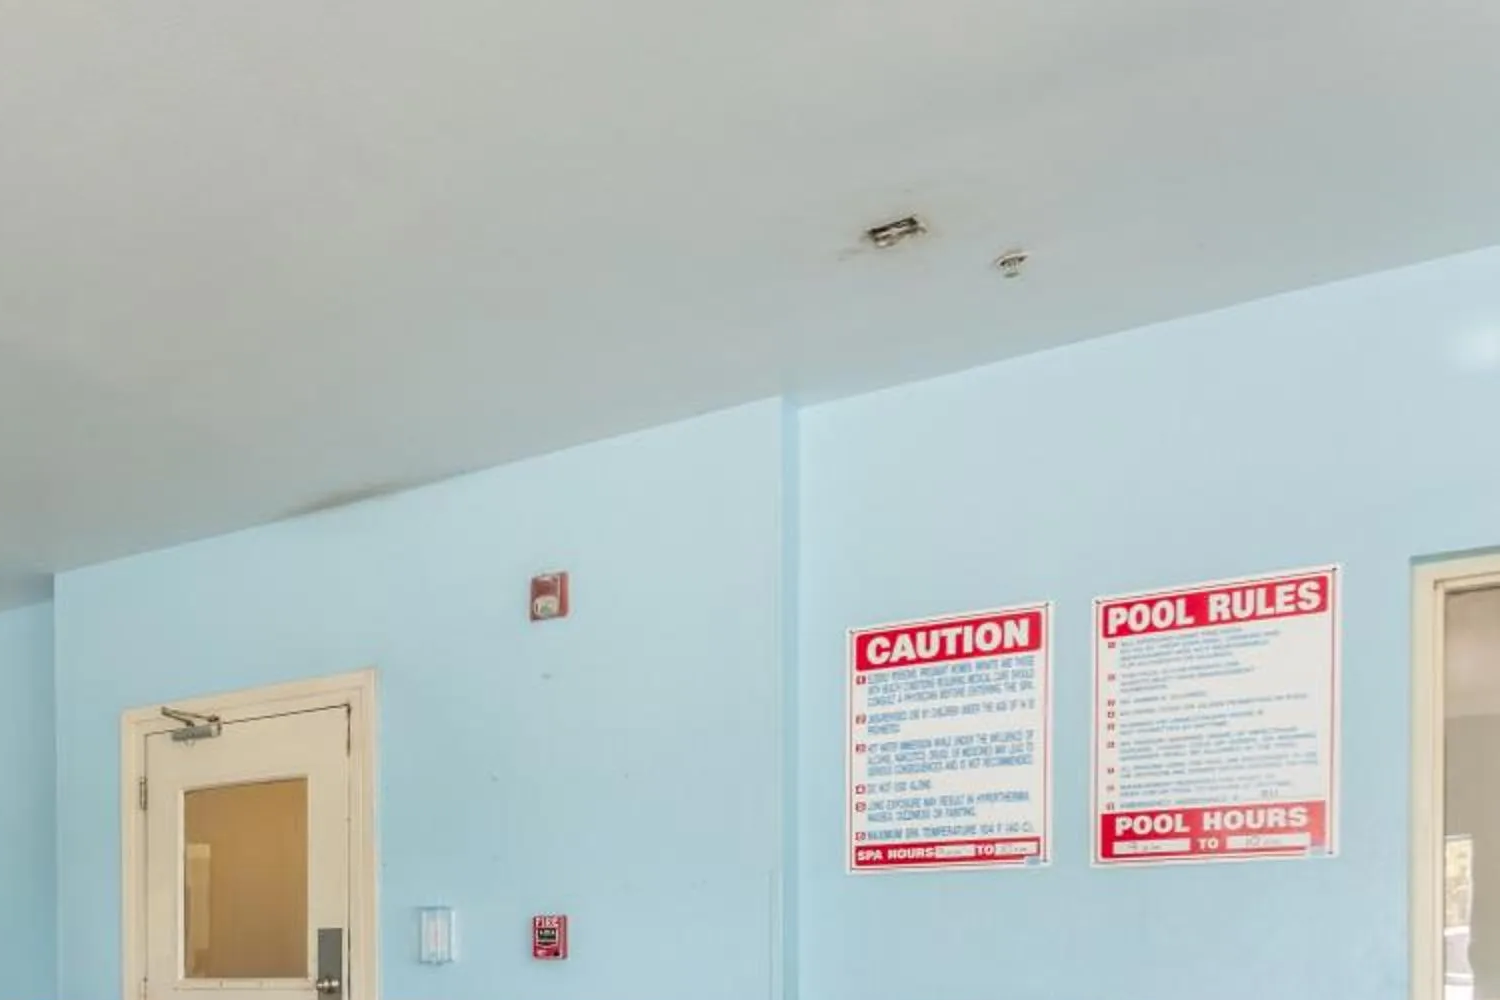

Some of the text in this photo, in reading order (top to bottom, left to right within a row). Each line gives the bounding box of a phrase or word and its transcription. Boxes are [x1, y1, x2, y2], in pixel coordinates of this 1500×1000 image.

[1107, 580, 1322, 635] POOL RULES
[866, 617, 1030, 665] CAUTION
[1115, 806, 1309, 837] POOL HOURS
[857, 848, 883, 862] SPA
[975, 843, 995, 857] TO
[1196, 837, 1219, 850] TO
